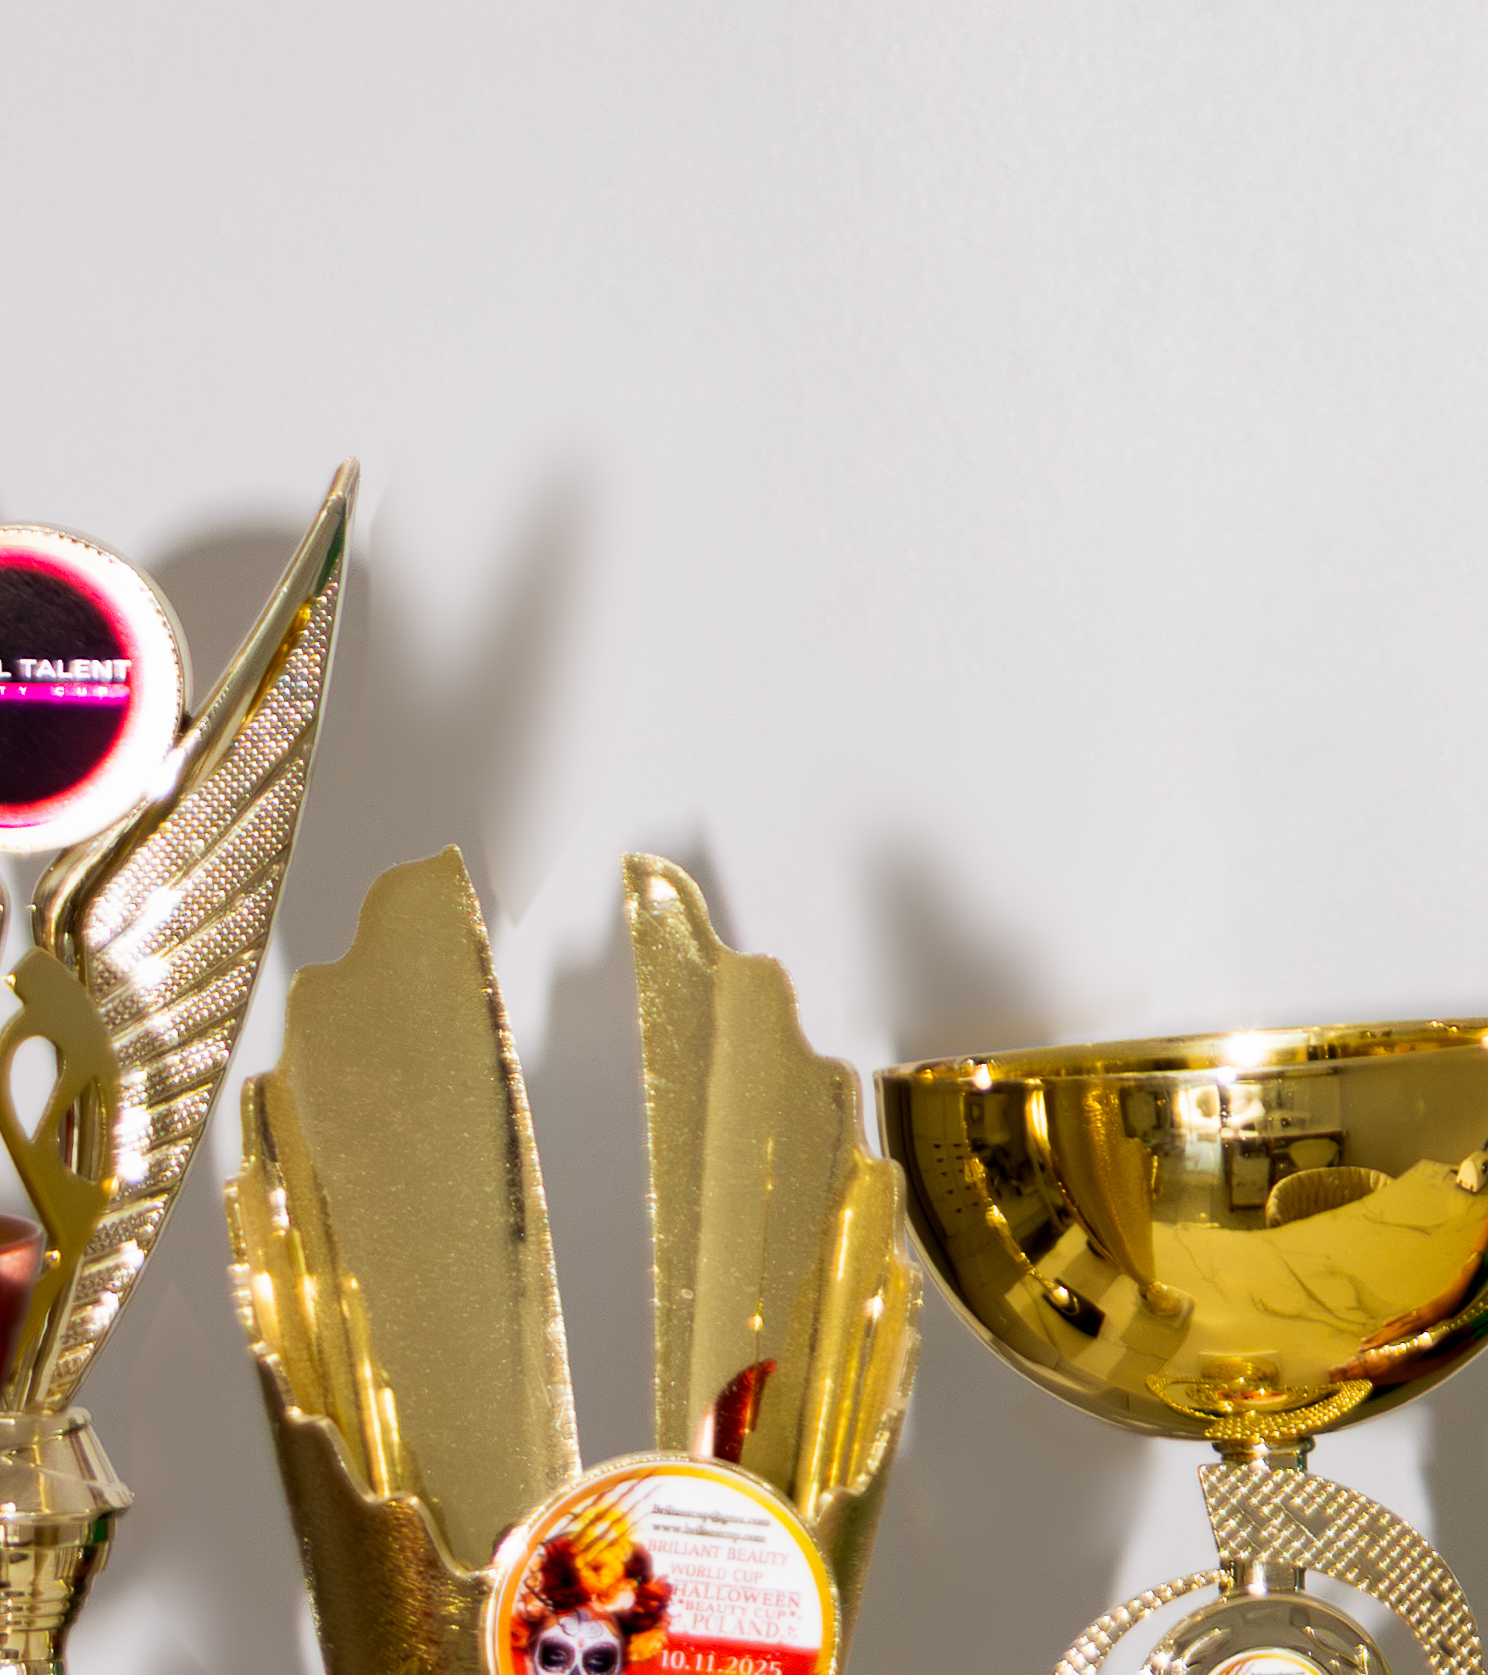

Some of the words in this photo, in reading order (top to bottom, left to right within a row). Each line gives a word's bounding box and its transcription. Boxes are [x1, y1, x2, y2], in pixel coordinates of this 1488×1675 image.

[18, 658, 131, 680] TALENT
[54, 685, 109, 698] CUP
[726, 1546, 790, 1567] BEAUTY
[670, 1562, 728, 1581] WORLD
[733, 1568, 764, 1584] CUP
[672, 1582, 802, 1609] HALLOWEEN
[685, 1599, 749, 1617] BEAUTY
